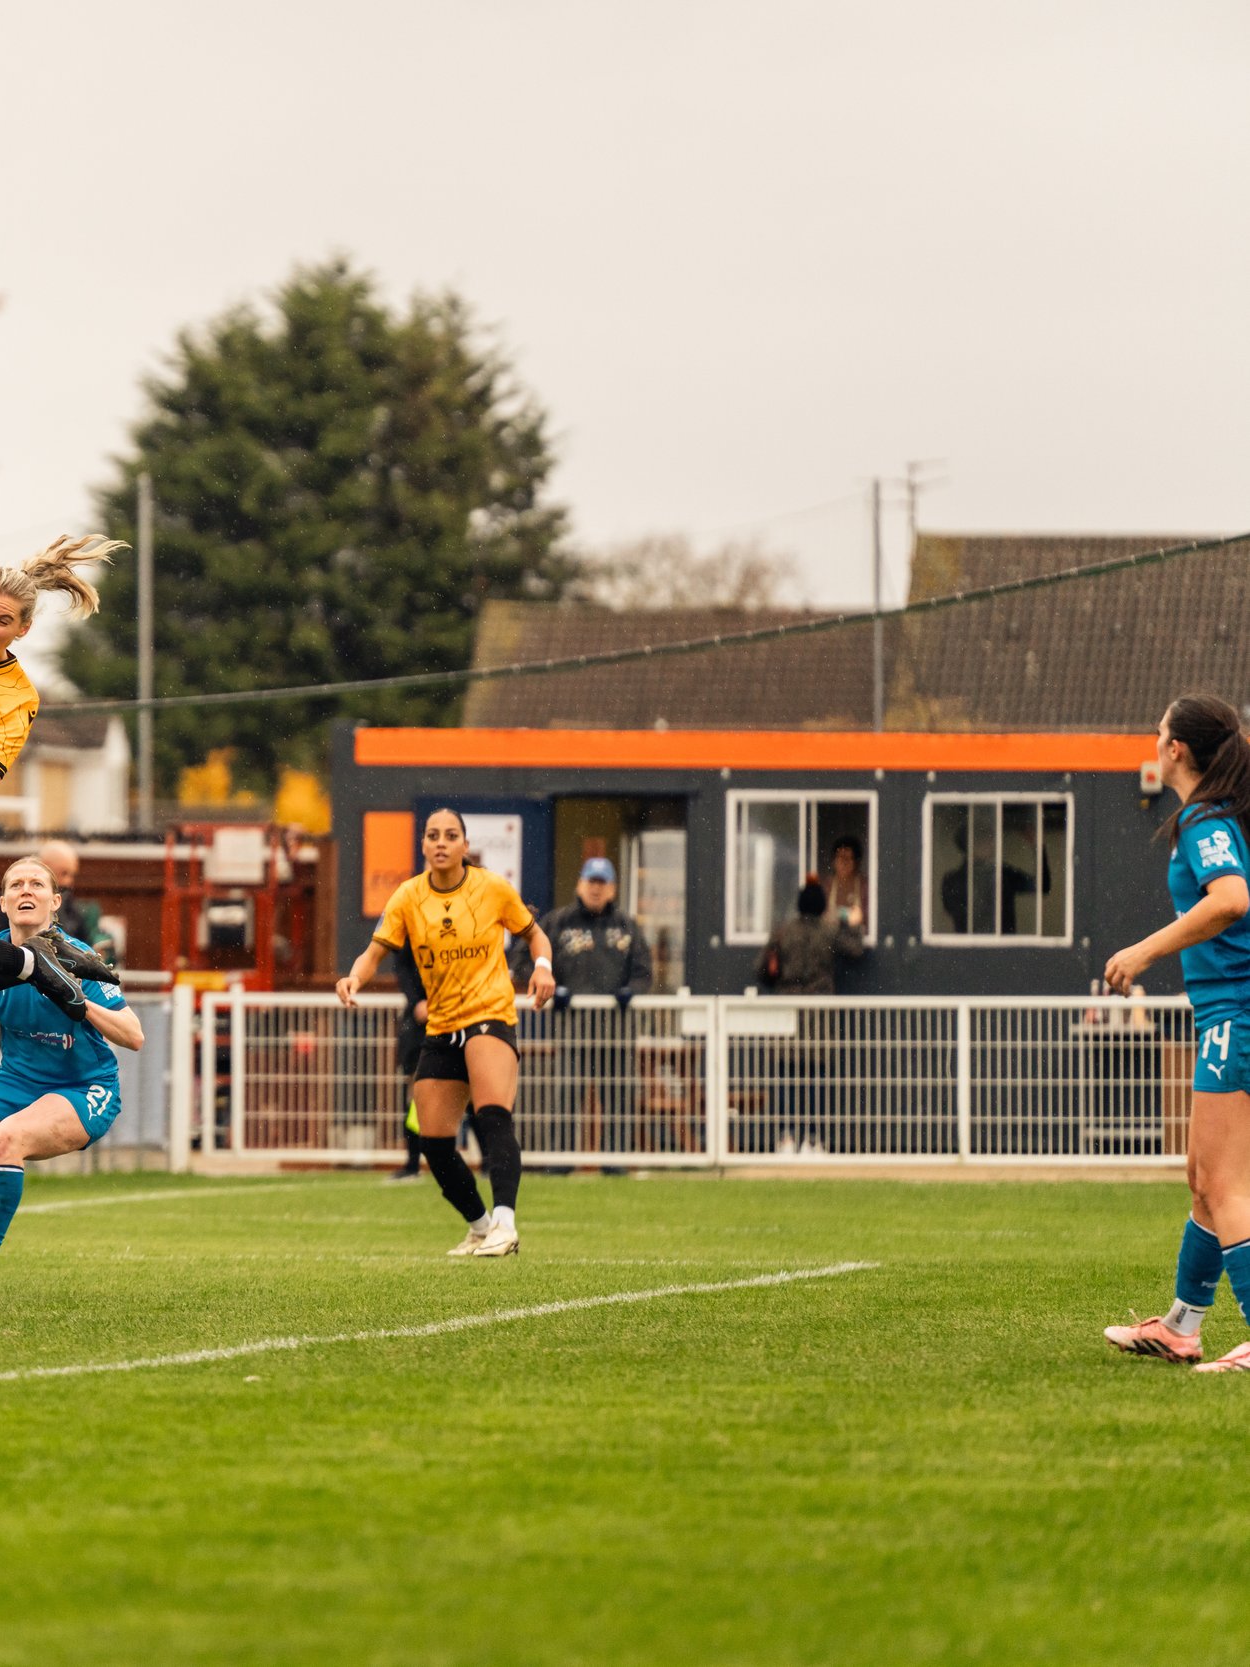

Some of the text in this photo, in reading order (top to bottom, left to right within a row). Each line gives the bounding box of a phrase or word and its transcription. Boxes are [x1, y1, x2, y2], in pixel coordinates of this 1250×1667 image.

[439, 943, 491, 966] galaxy
[1201, 1020, 1232, 1061] 14
[86, 1084, 113, 1116] 21
